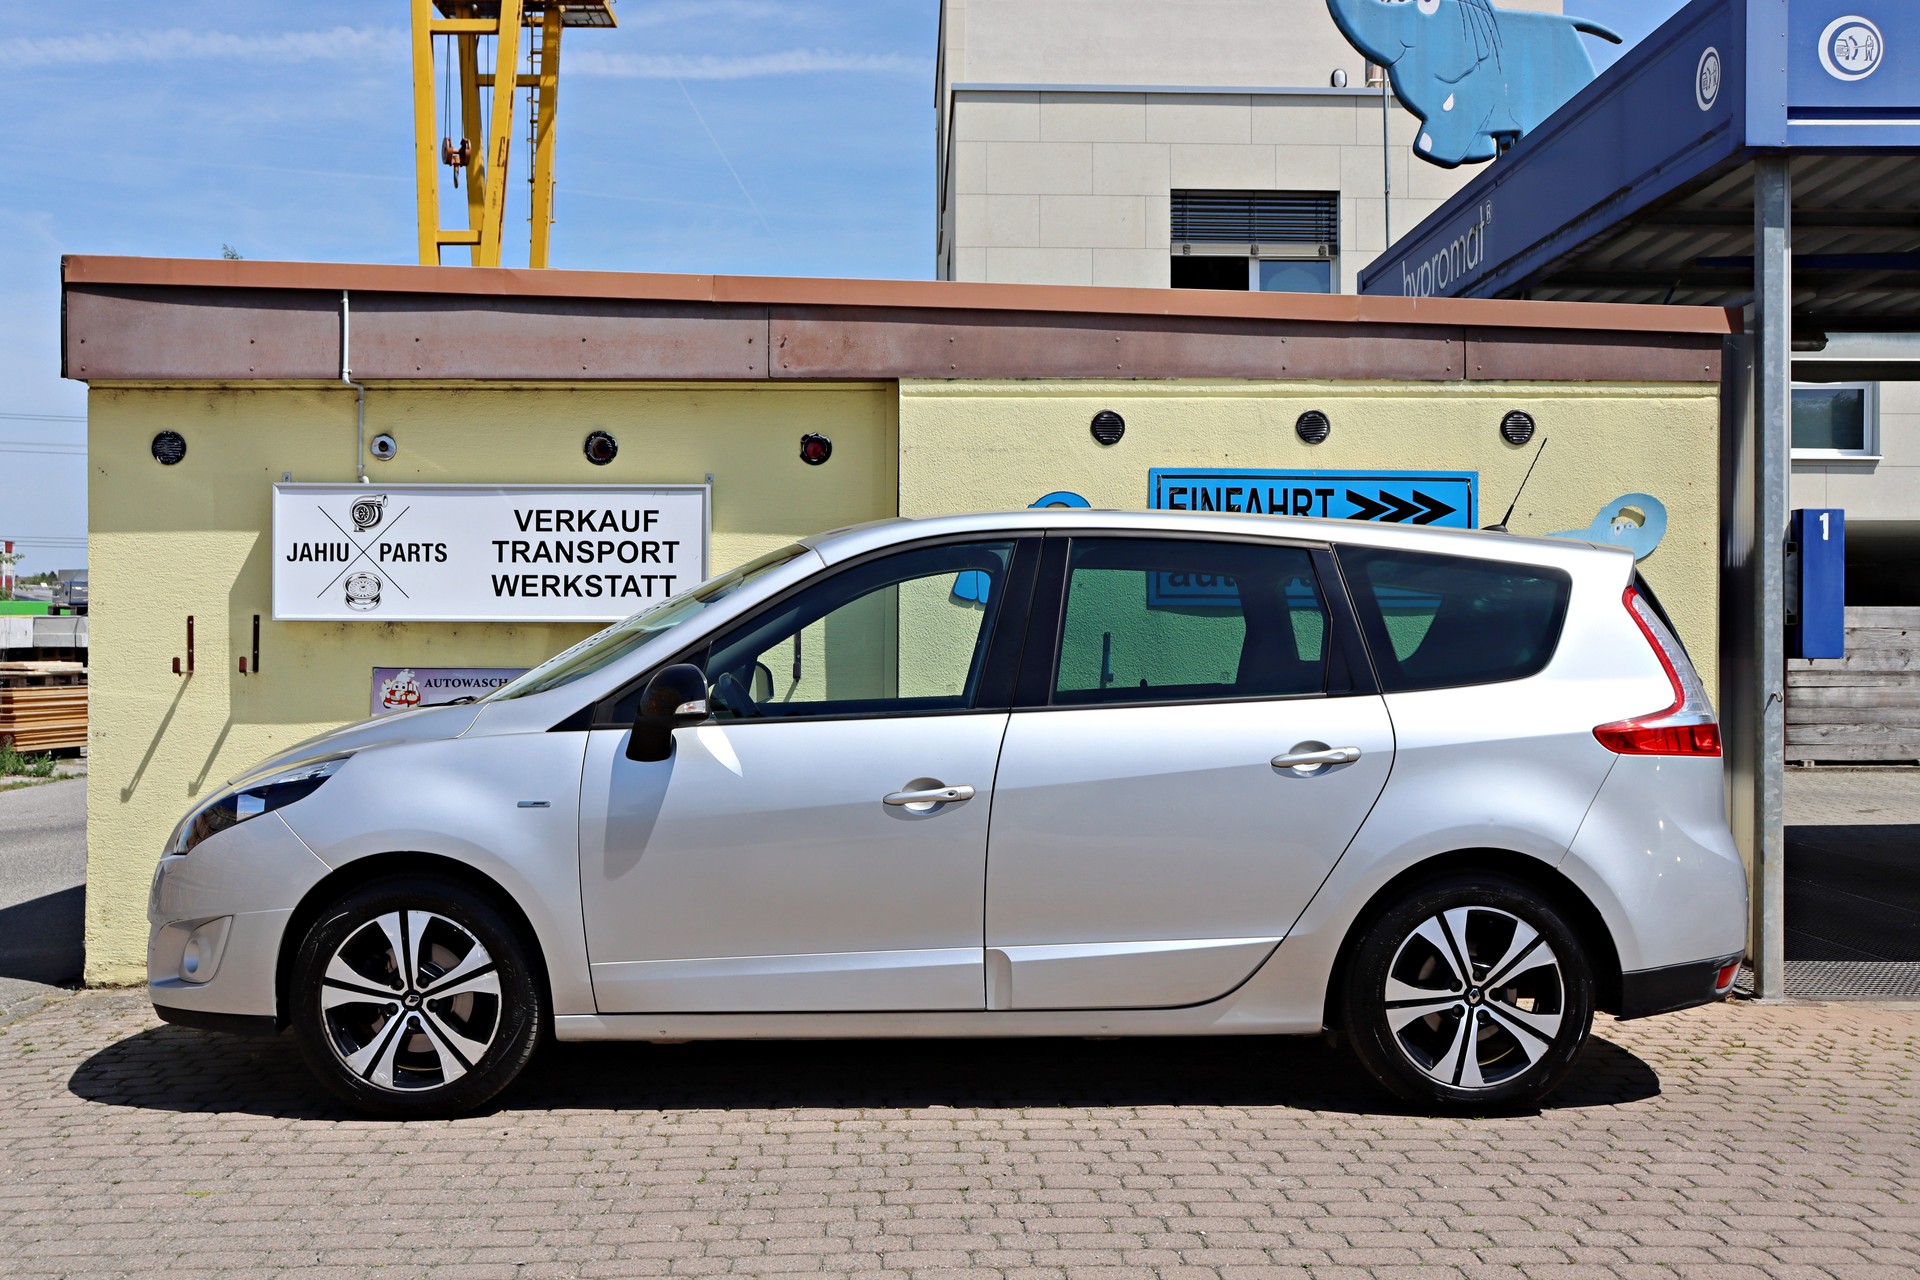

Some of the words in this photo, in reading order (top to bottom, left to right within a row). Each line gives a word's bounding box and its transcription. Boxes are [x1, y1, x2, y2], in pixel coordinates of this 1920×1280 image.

[1169, 487, 1335, 518] EINFAHRT
[514, 510, 659, 532] VERKAUF
[1819, 512, 1829, 541] 1
[286, 543, 349, 563] JAHIU
[380, 543, 447, 563] PARTS
[492, 541, 679, 563] TRANSPORT
[492, 575, 676, 597] WERKSTATT
